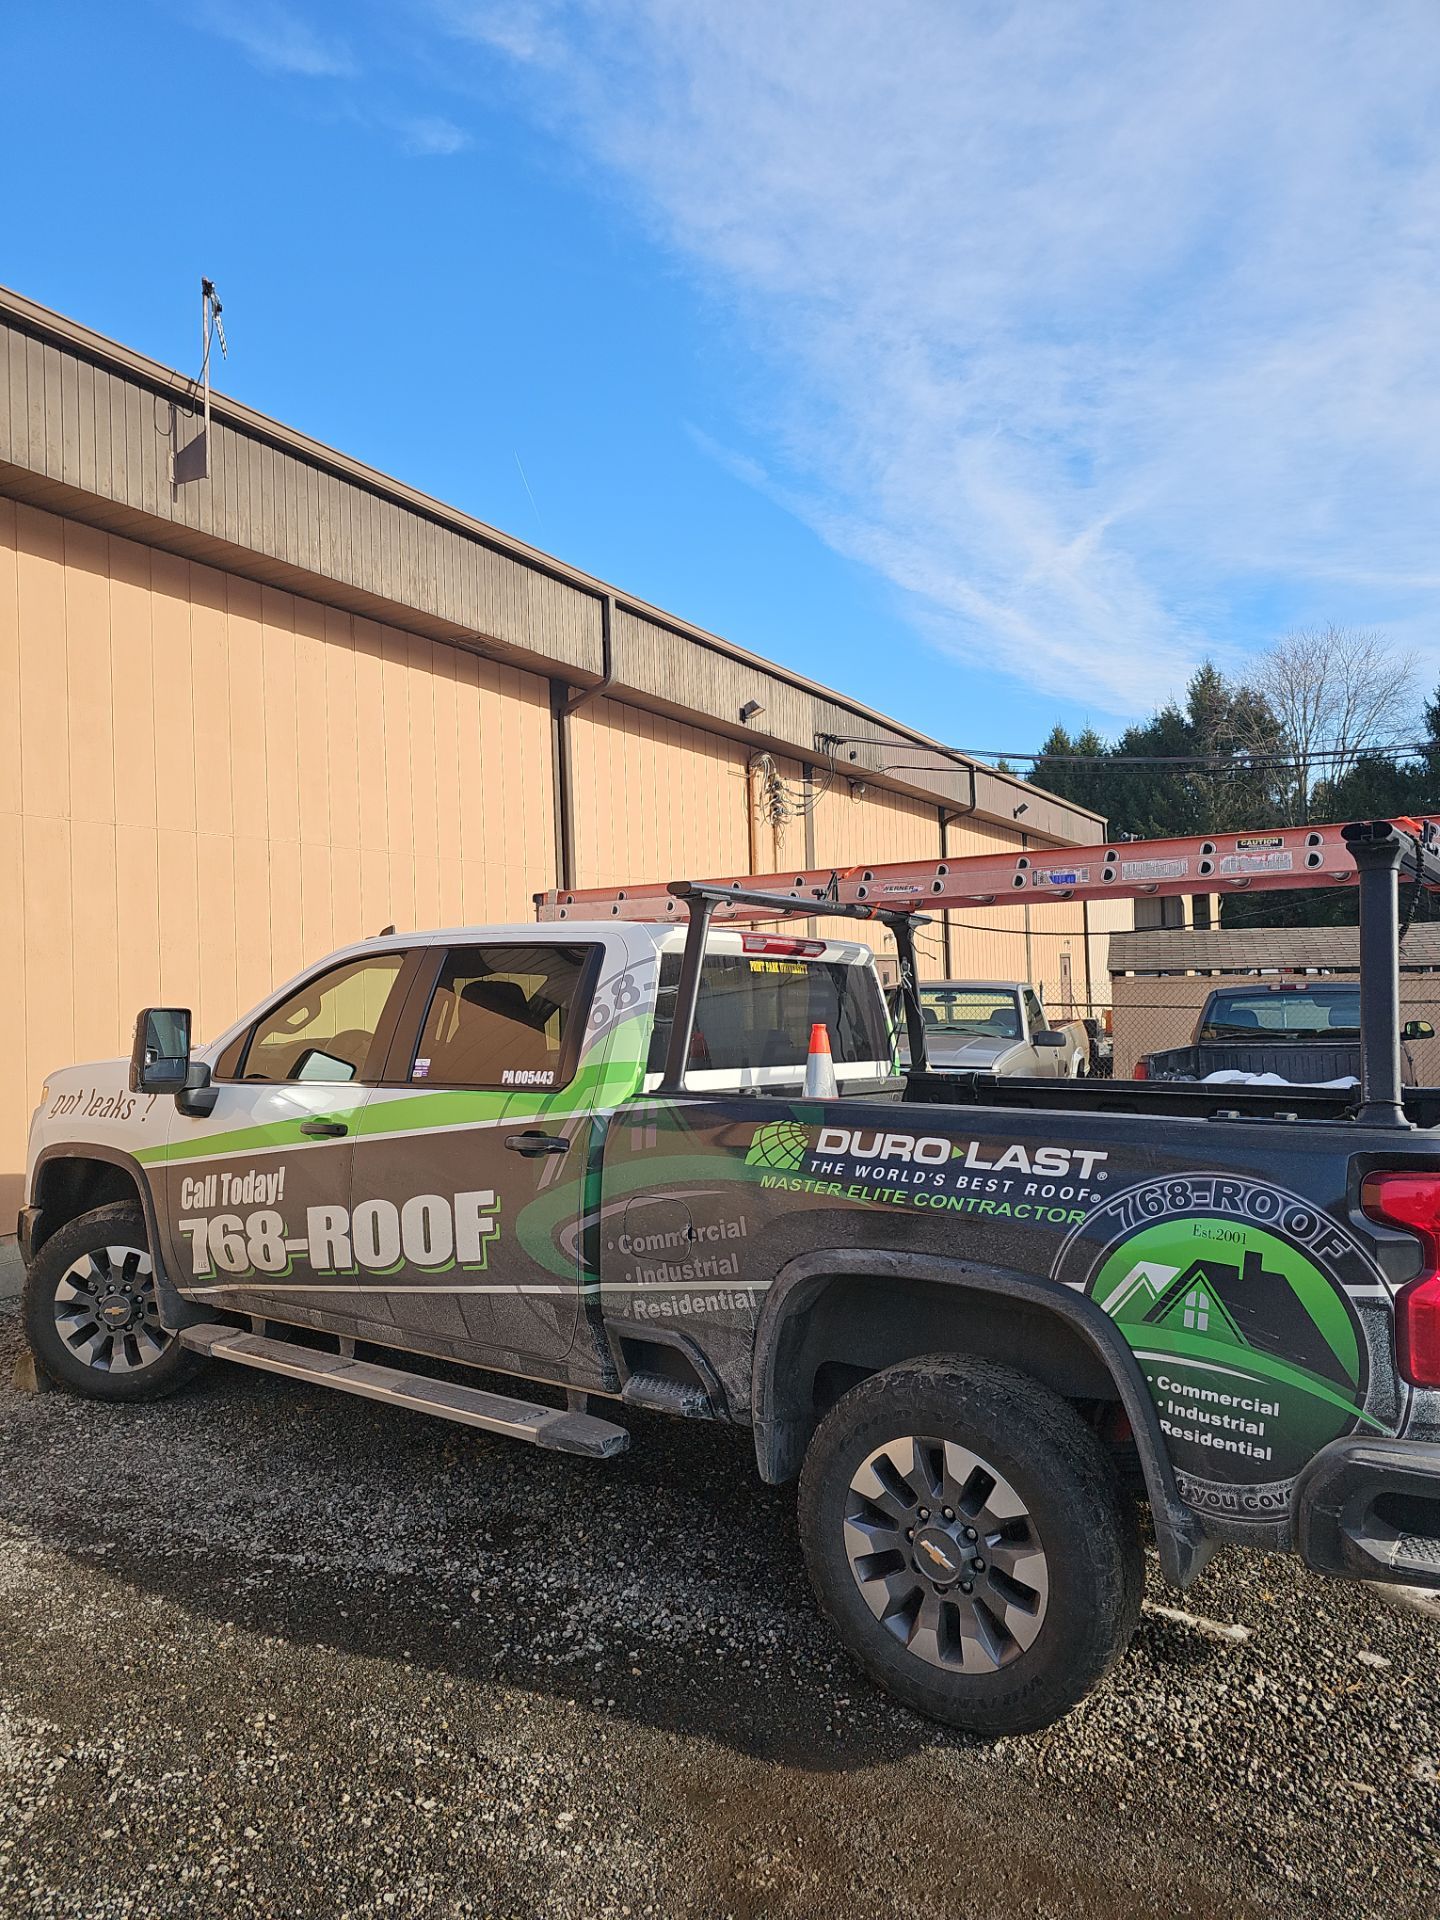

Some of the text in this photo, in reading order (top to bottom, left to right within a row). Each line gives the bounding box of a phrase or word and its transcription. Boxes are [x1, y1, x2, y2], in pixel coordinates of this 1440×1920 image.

[1240, 838, 1279, 846] CAUTION
[48, 1089, 83, 1119] got
[82, 1088, 136, 1120] leaks
[181, 1166, 286, 1211] Call Today!
[810, 1160, 844, 1175] THE
[855, 1166, 946, 1186] WORLD'S
[956, 1176, 1014, 1194] BEST
[759, 1175, 1087, 1226] MASTER ELITE CONTRACTOR
[178, 1189, 498, 1276] 768-ROOF
[618, 1216, 748, 1254] Commercial
[1107, 1180, 1353, 1260] 768-ROOF
[635, 1253, 739, 1286] Industrial
[632, 1287, 757, 1320] Residential
[1156, 1376, 1280, 1417] Commercial
[1168, 1400, 1265, 1437] Industrial
[1160, 1420, 1272, 1461] Residential
[1193, 1487, 1237, 1508] you
